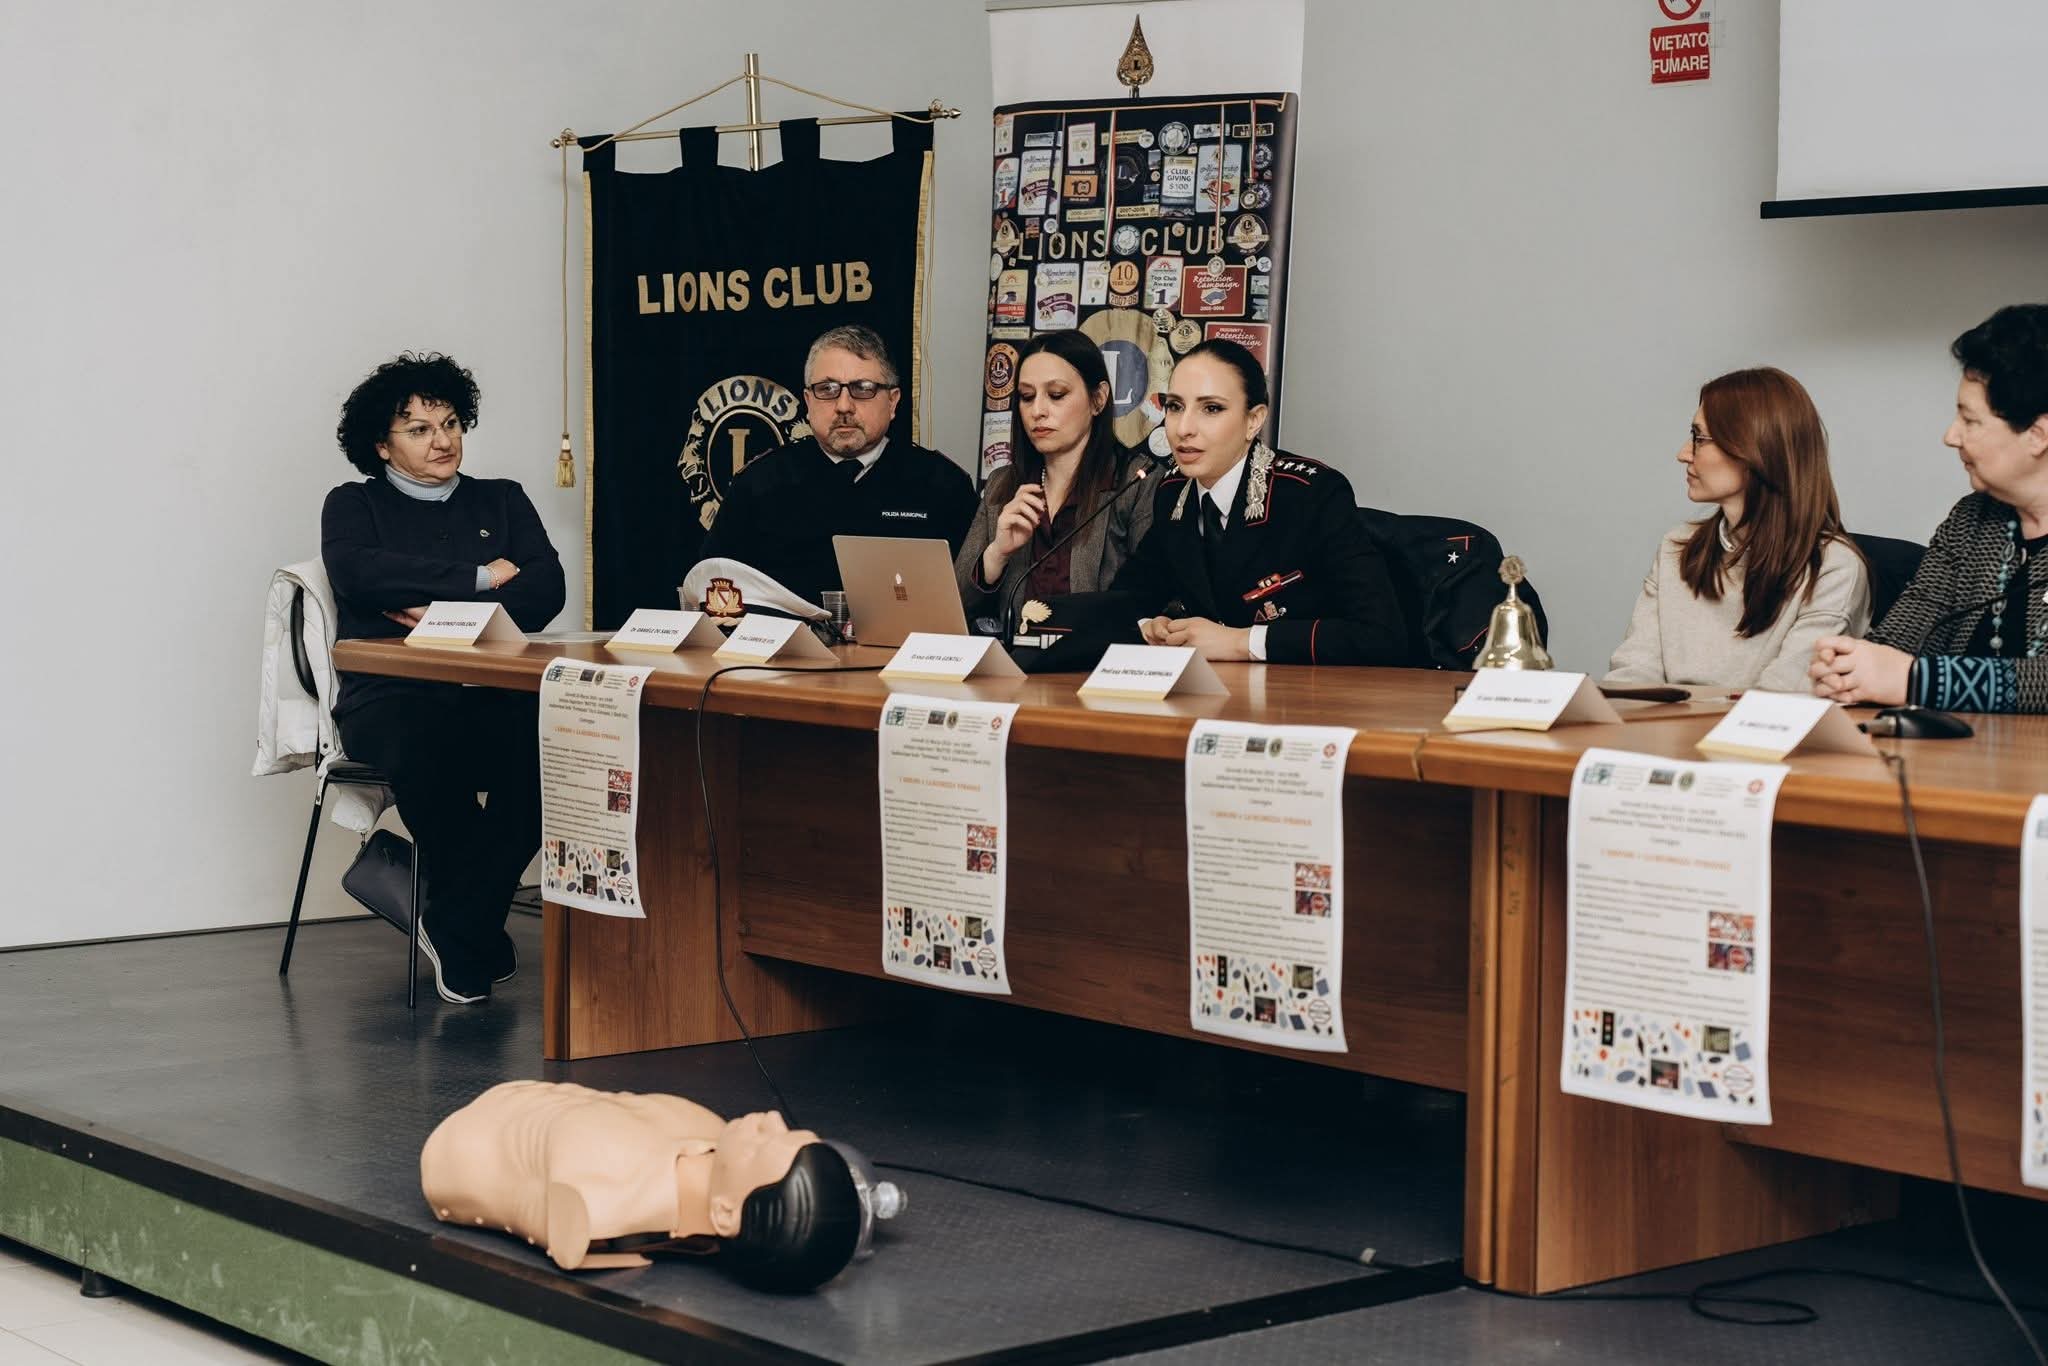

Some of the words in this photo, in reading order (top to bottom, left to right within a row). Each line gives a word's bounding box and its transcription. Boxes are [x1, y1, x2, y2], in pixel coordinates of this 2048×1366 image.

[1652, 32, 1709, 52] VIETATO
[1652, 55, 1709, 74] FUMARE
[1171, 168, 1189, 176] CLUB
[1167, 175, 1192, 183] GIVING
[1018, 229, 1106, 261] LIONS
[1141, 225, 1225, 256] CLUB
[1116, 264, 1134, 280] 10
[1151, 274, 1162, 284] Top
[1162, 274, 1178, 282] Club
[1153, 280, 1175, 288] Award
[1192, 275, 1234, 286] Retention
[1197, 280, 1241, 291] Campaign
[637, 269, 750, 315] LIONS
[763, 261, 873, 309] CLUB
[1154, 288, 1169, 305] 1
[1214, 331, 1256, 340] Retention
[702, 379, 793, 417] LIONS
